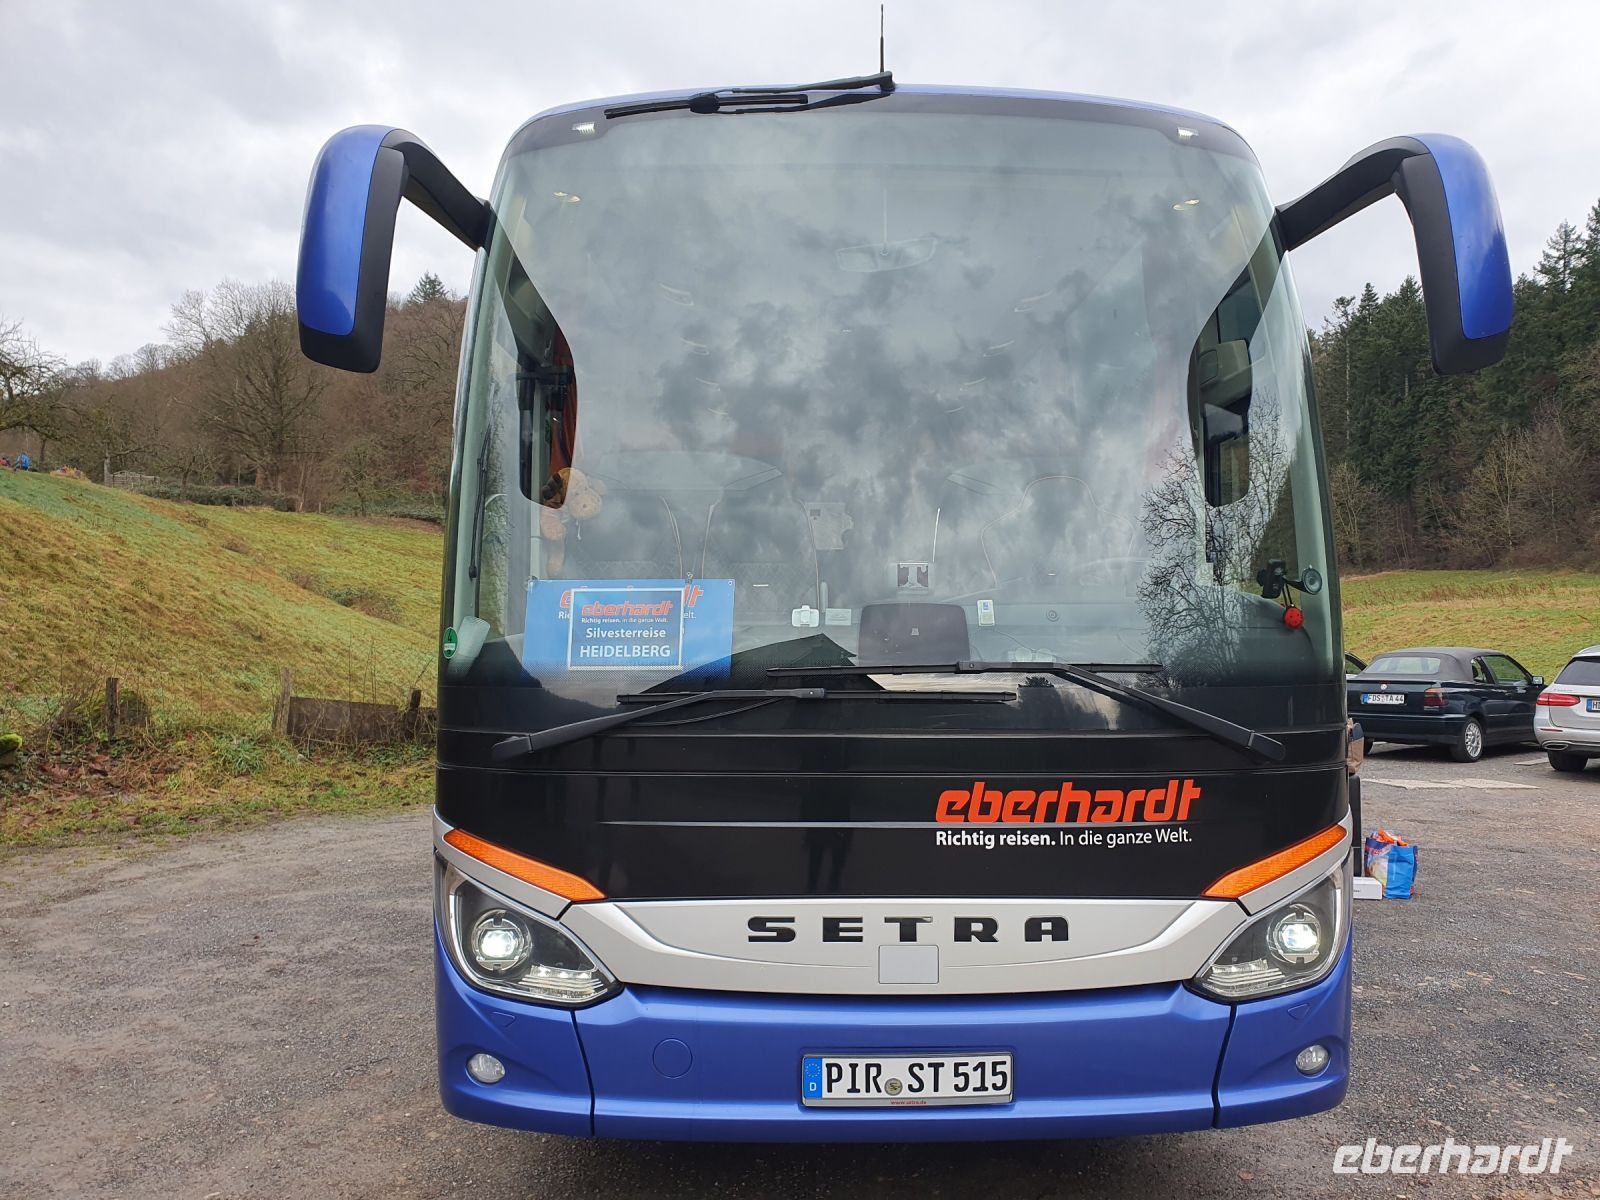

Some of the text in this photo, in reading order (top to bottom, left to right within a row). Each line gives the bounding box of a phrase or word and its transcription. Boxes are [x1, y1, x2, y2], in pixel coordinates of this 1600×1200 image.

[582, 601, 673, 616] eberhardt
[581, 617, 601, 625] Richtig
[586, 627, 667, 638] Silvesterreise
[580, 645, 671, 658] HEIDELBERG
[935, 779, 1201, 824] eberhardt
[936, 828, 1193, 849] Richtig reisen. In die ganze Welt.
[747, 916, 1069, 943] SETRA
[825, 1060, 1008, 1093] PIR ST 515
[809, 1082, 817, 1091] D
